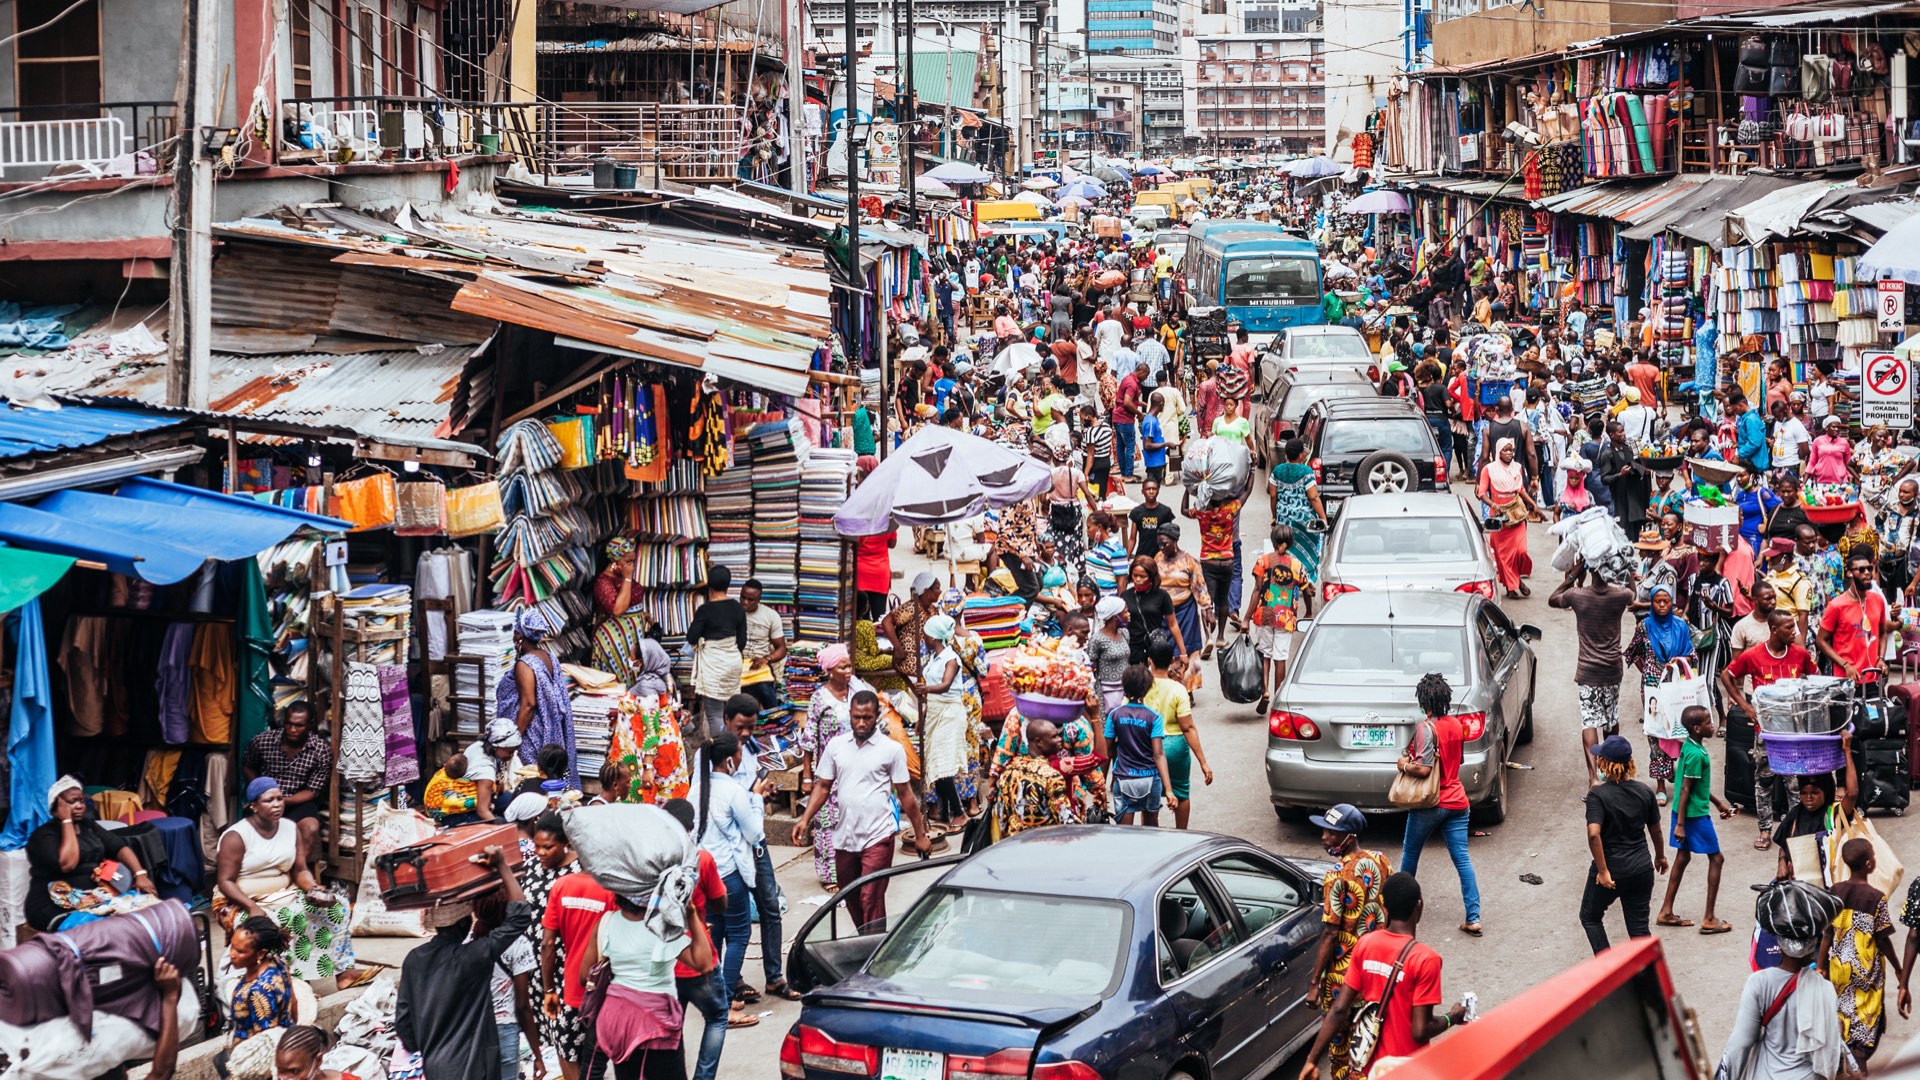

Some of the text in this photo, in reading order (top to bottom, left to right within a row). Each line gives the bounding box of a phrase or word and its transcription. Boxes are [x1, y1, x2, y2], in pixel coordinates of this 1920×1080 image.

[1879, 282, 1903, 291] NO PARKING
[1865, 412, 1910, 420] PROHIBITED
